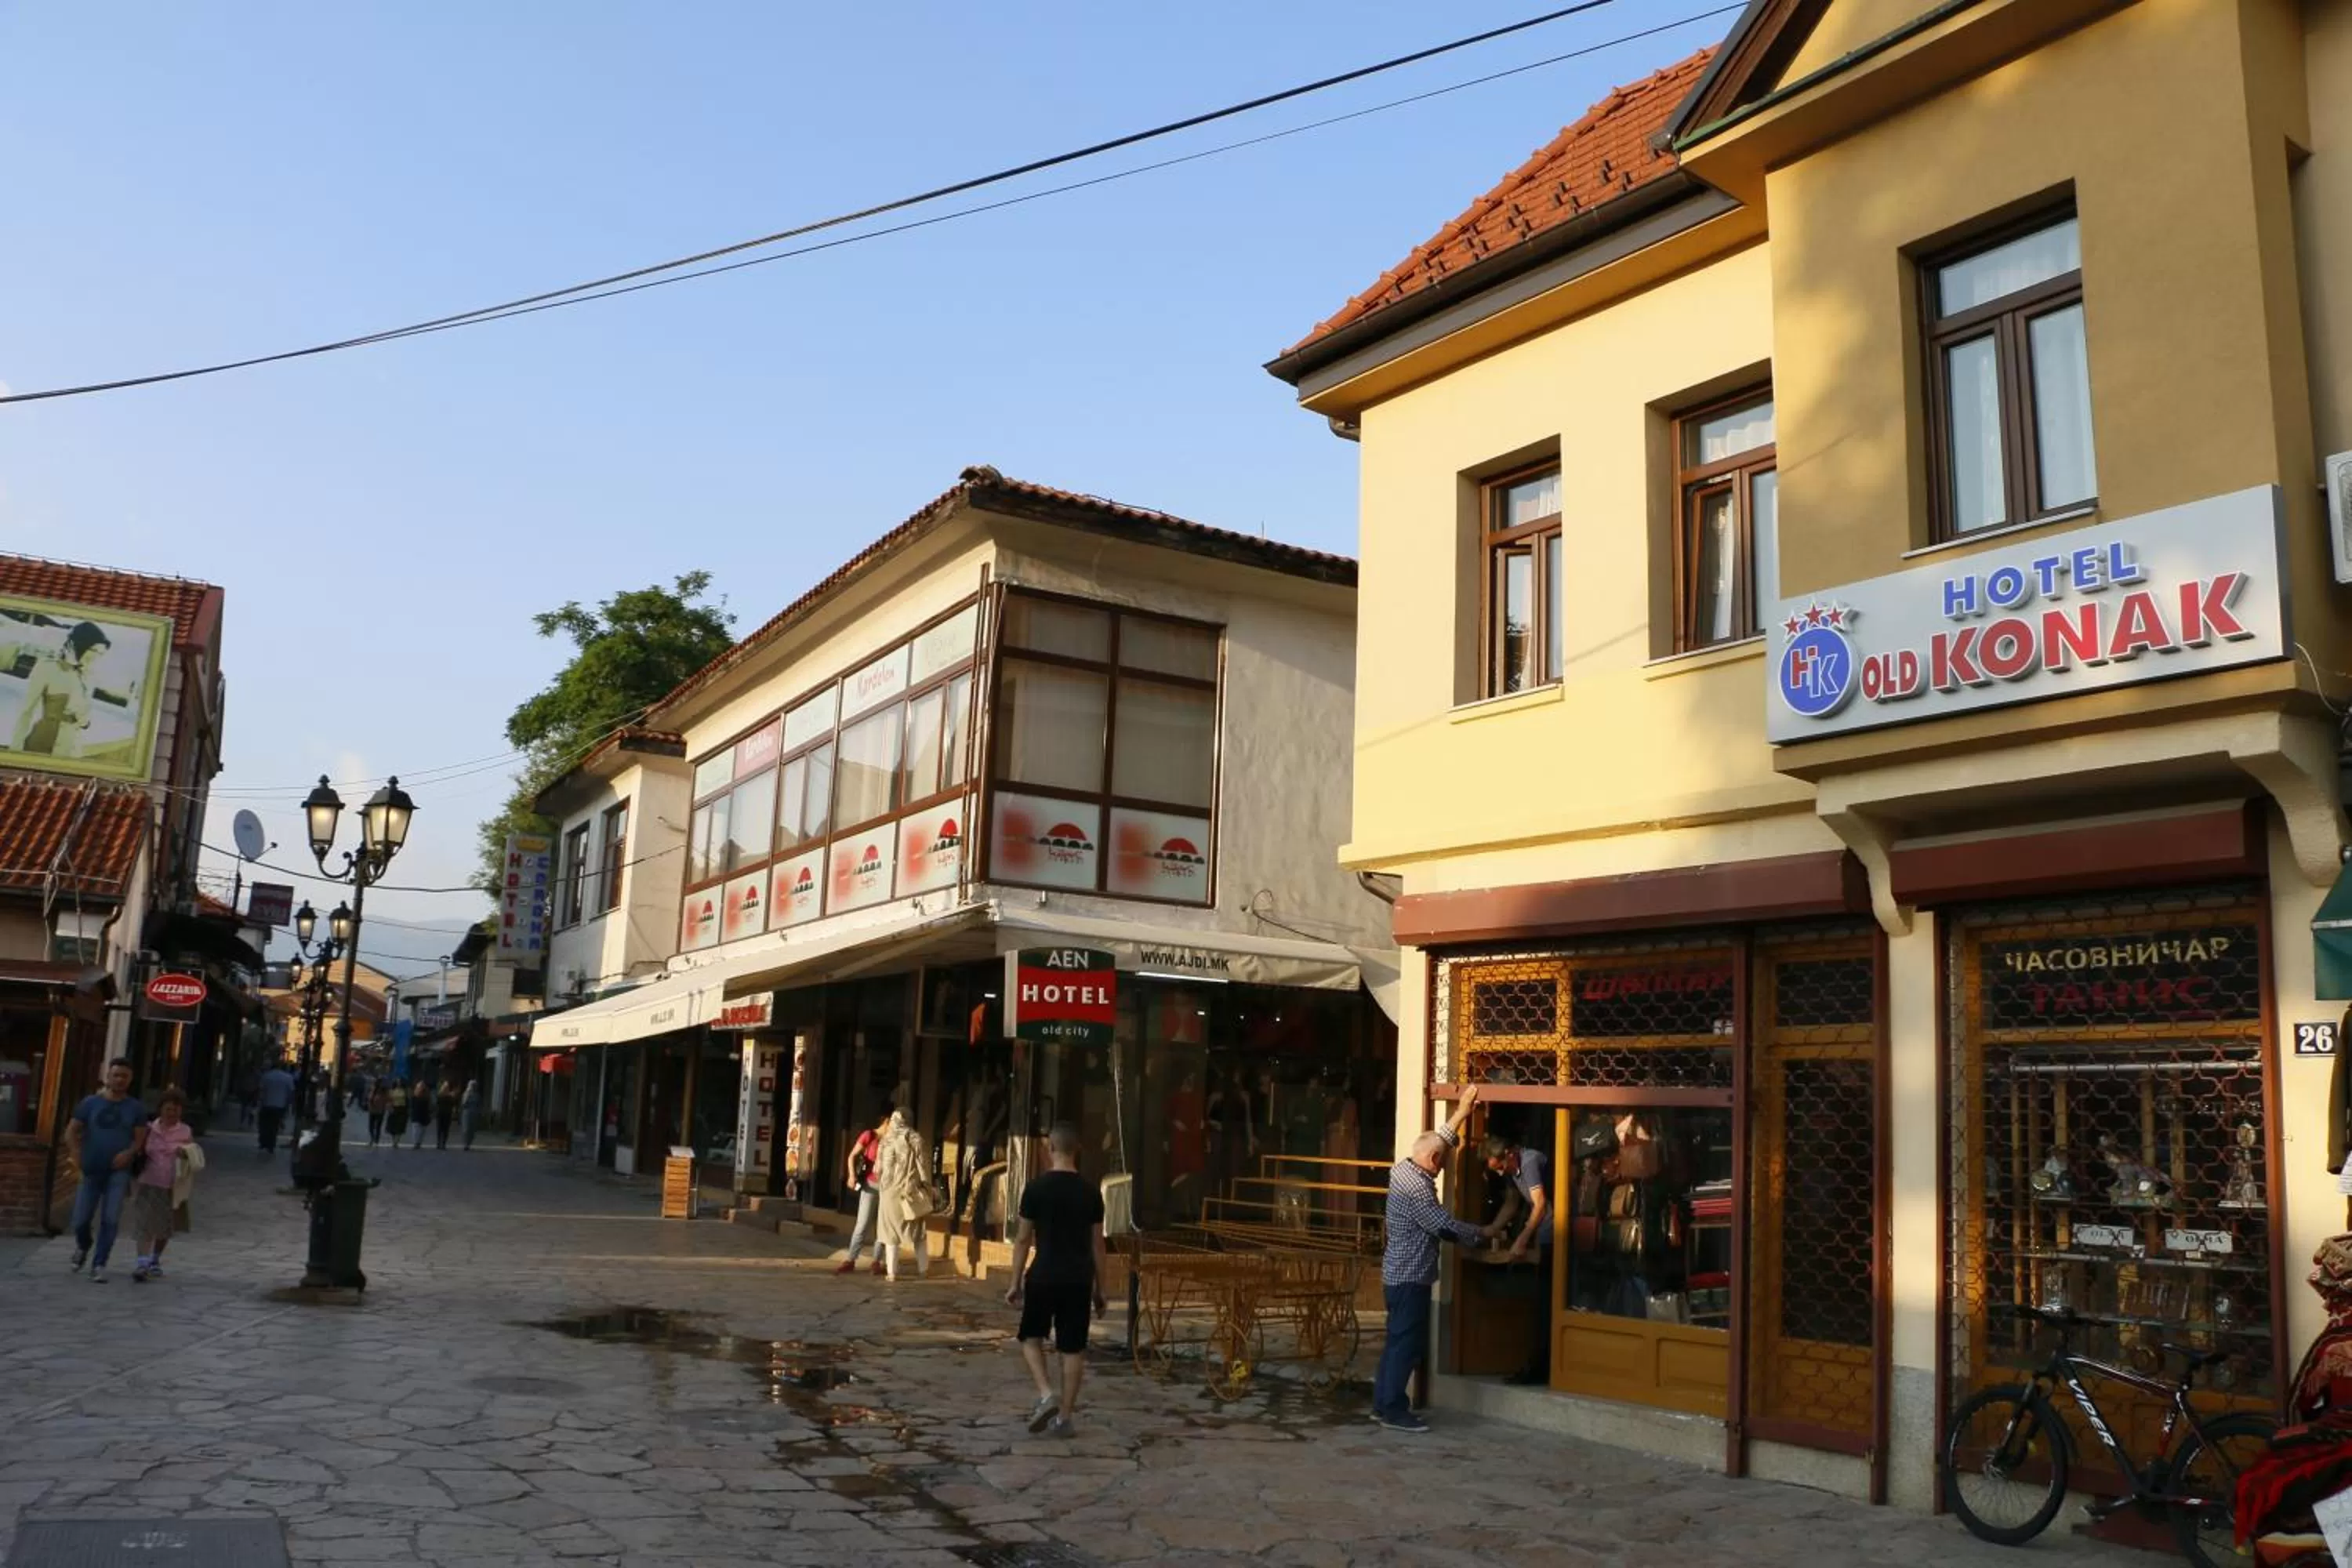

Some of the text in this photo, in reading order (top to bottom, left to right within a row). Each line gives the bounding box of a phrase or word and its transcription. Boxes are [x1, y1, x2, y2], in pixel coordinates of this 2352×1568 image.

[1943, 542, 2138, 616] HOTEL
[1861, 572, 2247, 701] OLD KONAK
[1047, 949, 1089, 969] AEN
[1141, 951, 1230, 972] WWW.AJDI.MK
[2005, 938, 2230, 971] ЧАСОВНИЧАР
[1022, 984, 1109, 1004] HOTEL
[1042, 1025, 1090, 1037] old city
[2299, 1025, 2333, 1052] 26
[753, 1051, 775, 1167] HOTEL
[2068, 1379, 2115, 1446] VIPER
